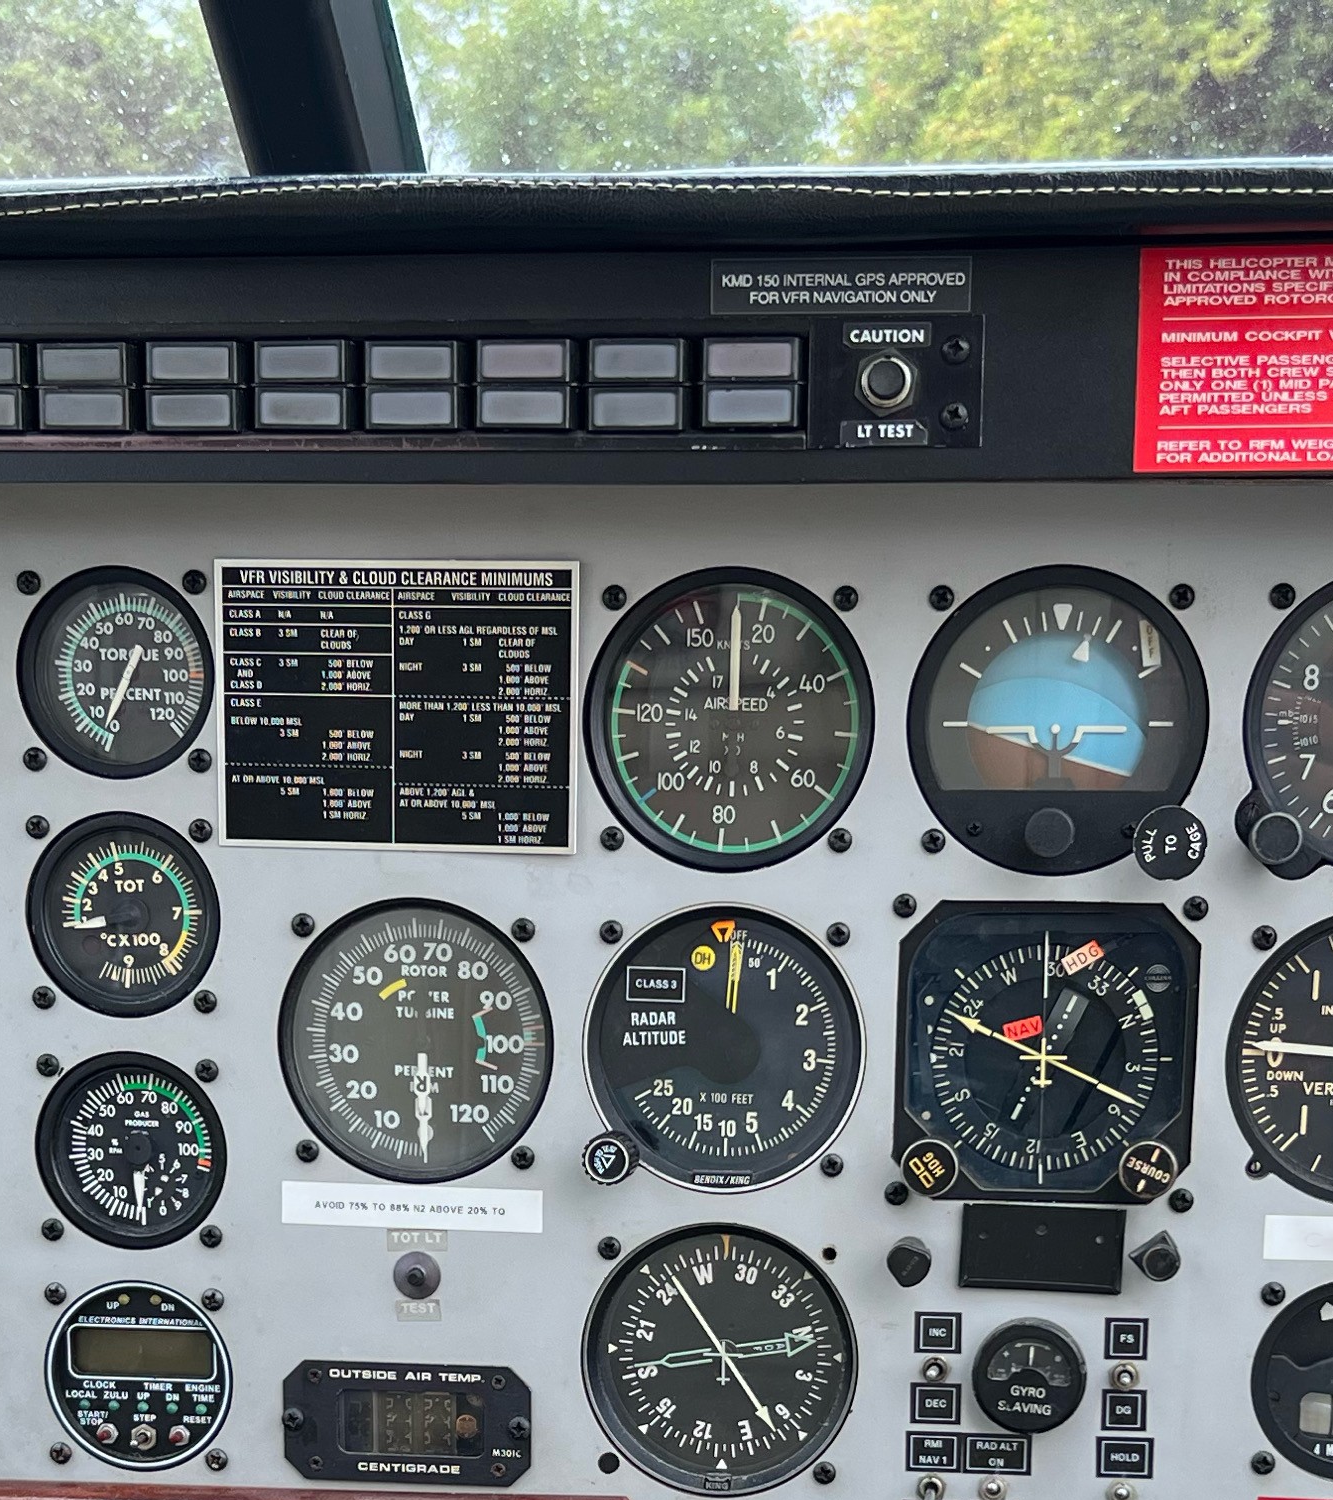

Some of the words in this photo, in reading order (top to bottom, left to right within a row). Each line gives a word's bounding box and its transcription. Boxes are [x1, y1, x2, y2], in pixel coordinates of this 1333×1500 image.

[1166, 260, 1203, 270] THIS
[1209, 257, 1319, 269] HELICOPTER
[722, 275, 753, 288] KMD
[757, 275, 779, 286] 150
[783, 274, 851, 286] INTERNAL
[855, 274, 885, 286] GPS
[888, 273, 965, 286] APPROVED
[1164, 272, 1183, 283] IN
[1188, 270, 1301, 282] COMPLIANCE
[1164, 282, 1265, 294] LIMITATIONS
[750, 292, 779, 304] FOR
[783, 292, 809, 304] VFR
[813, 291, 897, 303] NAVIGATION
[900, 290, 937, 303] ONLY
[1164, 294, 1258, 306] APPROVED
[849, 330, 925, 342] CAUTION
[1161, 330, 1238, 343] MINIMUM
[1245, 329, 1323, 342] COCKPIT
[1161, 356, 1250, 368] SELECTIVE
[1161, 368, 1206, 379] THEN
[1211, 367, 1261, 378] BOTH
[1267, 366, 1321, 378] CREW
[1160, 380, 1204, 392] ONLY
[1211, 380, 1249, 391] ONE
[1253, 380, 1273, 391] (1)
[1279, 379, 1313, 390] MID
[1159, 392, 1255, 404] PERMITTED
[1261, 390, 1327, 402] UNLESS
[1159, 404, 1191, 416] AFT
[1196, 403, 1313, 416] PASSENGERS
[857, 425, 873, 438] LT
[878, 424, 914, 438] TEST
[1157, 440, 1210, 452] REFER
[1217, 440, 1242, 451] TO
[1249, 439, 1285, 450] RFM
[1155, 452, 1193, 464] FOR
[1197, 451, 1302, 464] ADDITIONAL
[240, 570, 266, 584] VFR
[269, 571, 336, 585] VISIBILITY
[339, 572, 351, 585] &
[353, 571, 396, 586] CLOUD
[401, 572, 477, 586] CLEARANCE
[481, 572, 553, 586] MINIMUMS
[115, 880, 145, 894] TOT
[401, 965, 448, 978] ROTOR
[631, 1011, 677, 1026] RADAR
[623, 1031, 687, 1046] ALTITUDE
[315, 1200, 345, 1210] AVOID
[349, 1201, 369, 1210] 75%
[373, 1202, 386, 1211] TO
[390, 1203, 409, 1212] 88%
[413, 1204, 425, 1212] N2
[429, 1204, 463, 1214] ABOVE
[467, 1206, 487, 1215] 20%
[391, 1231, 420, 1244] TOT
[425, 1232, 443, 1244] LT
[329, 1368, 397, 1380] OUTSIDE
[405, 1370, 432, 1381] AIR
[439, 1372, 486, 1383] TEMP.
[1010, 1386, 1046, 1398] GYRO
[1110, 1453, 1139, 1462] HOLD
[357, 1462, 461, 1475] CENTIGRADE
